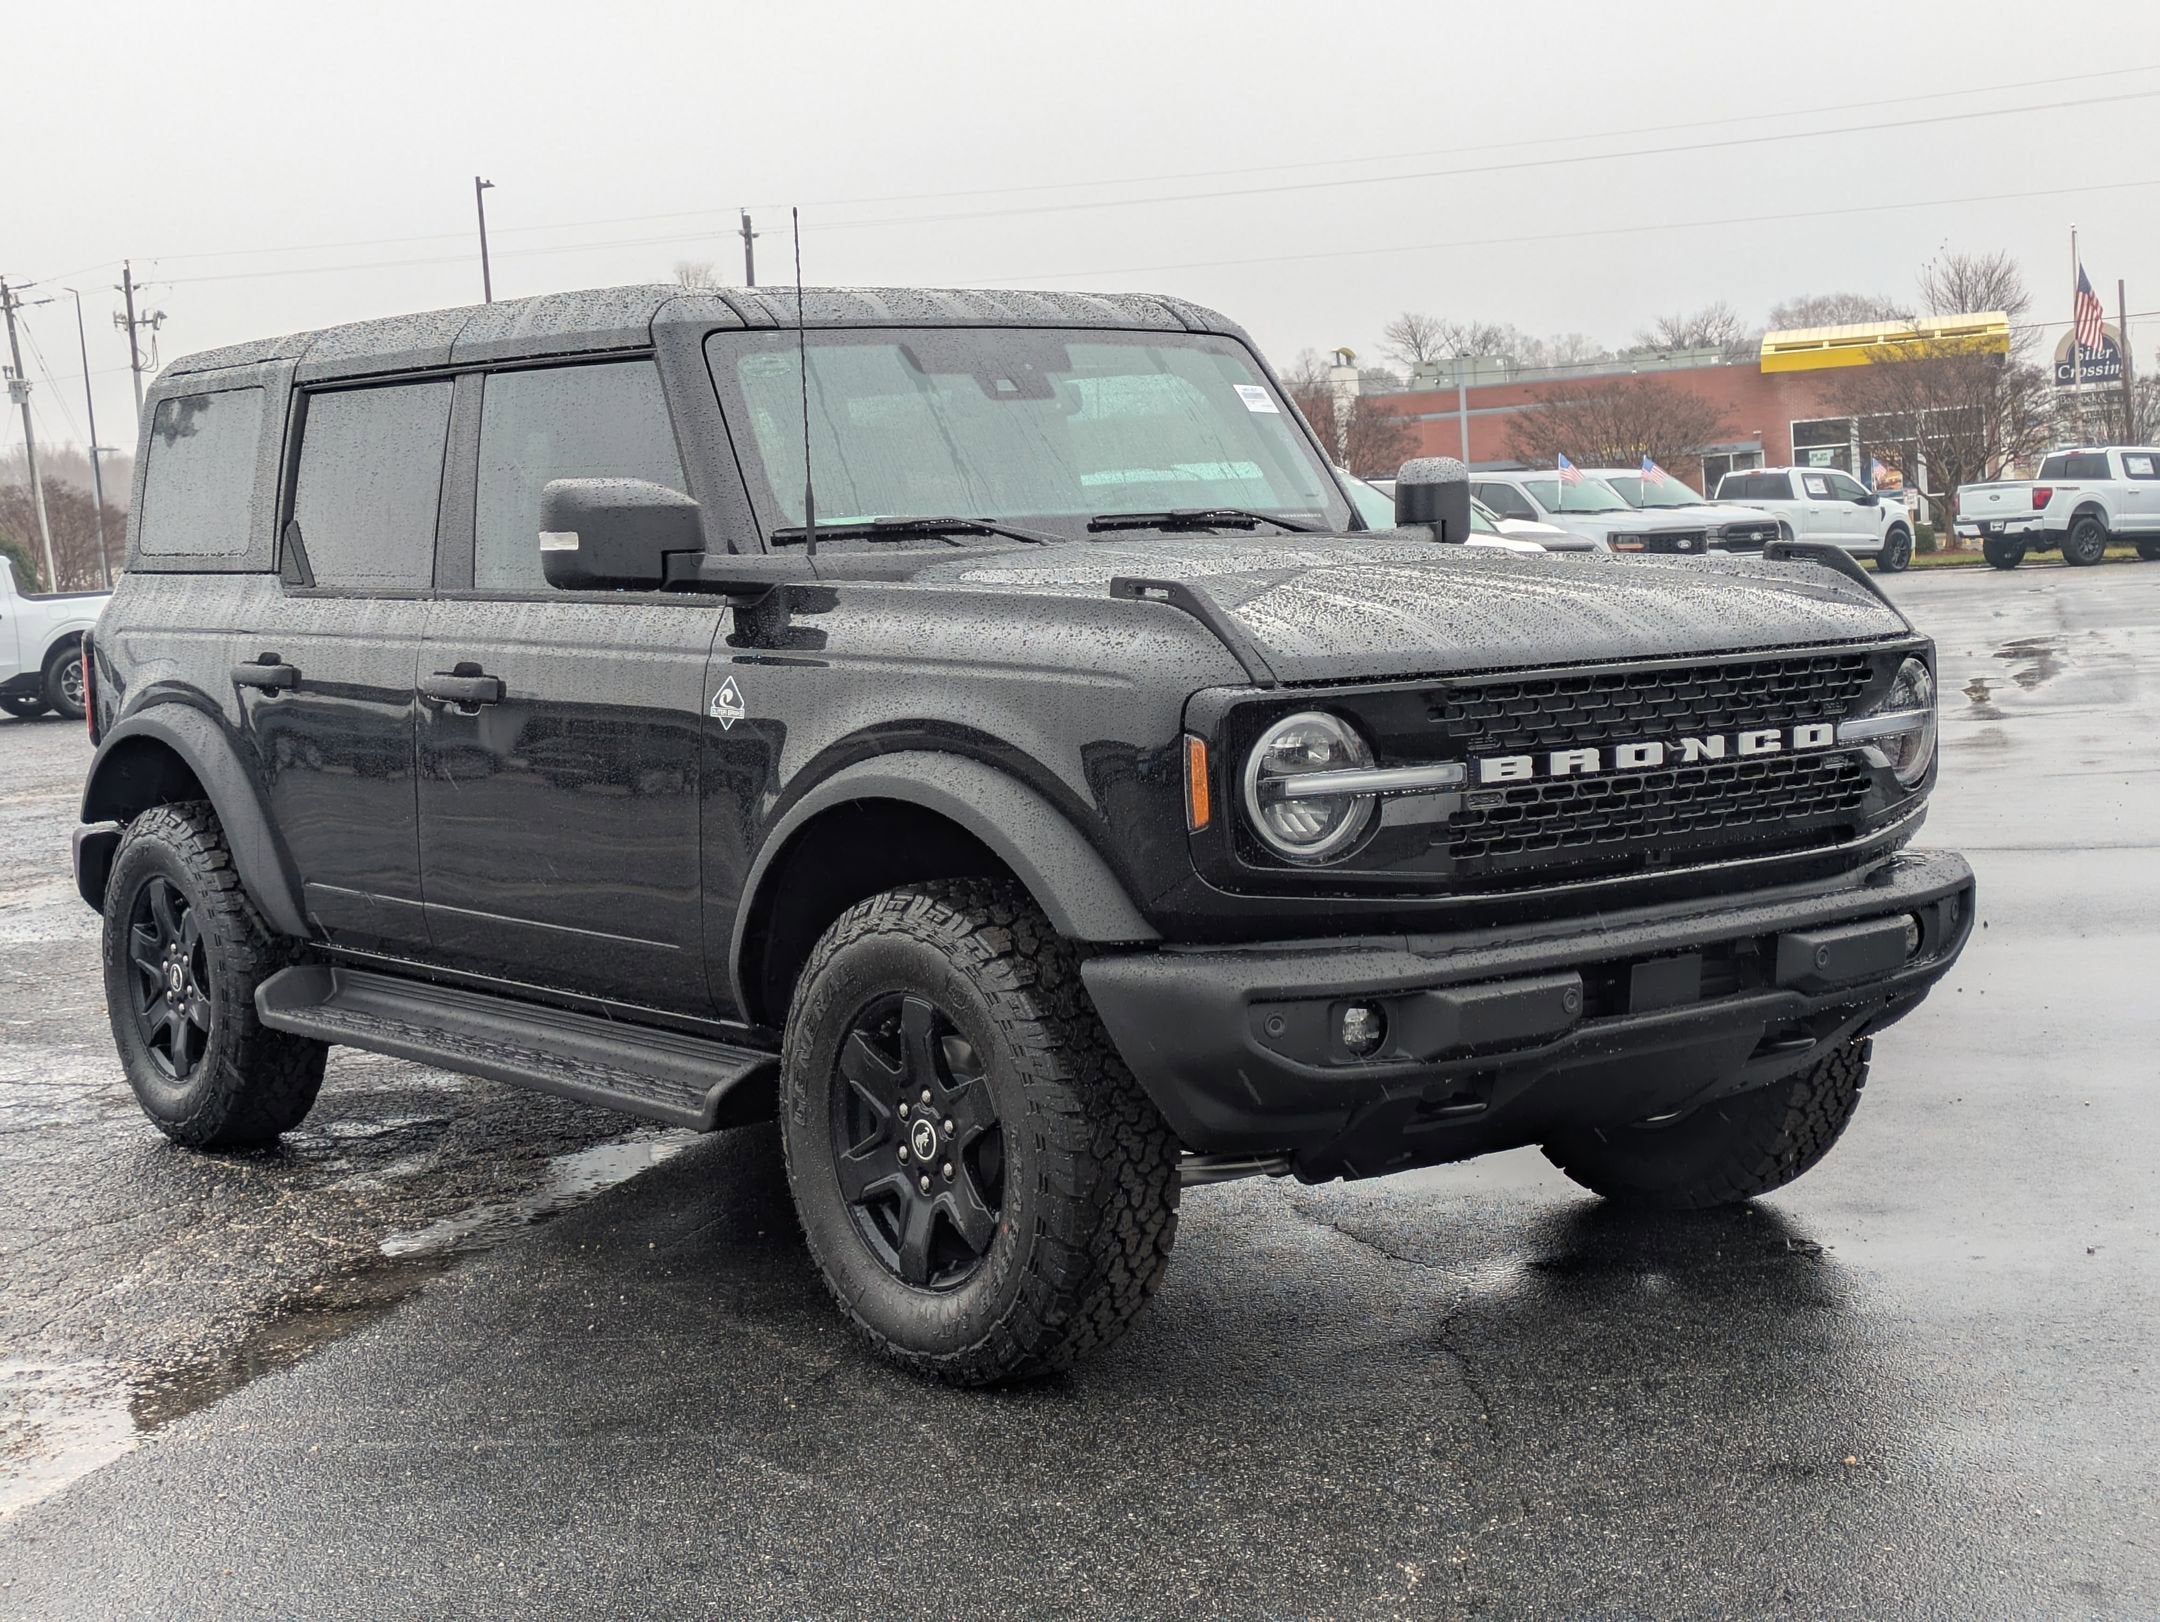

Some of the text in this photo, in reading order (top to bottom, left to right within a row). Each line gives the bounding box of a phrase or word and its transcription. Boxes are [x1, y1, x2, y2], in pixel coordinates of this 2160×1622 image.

[2078, 347, 2113, 361] Siler
[1480, 723, 1834, 784] BRONCO
[794, 960, 854, 1126] GENERAL
